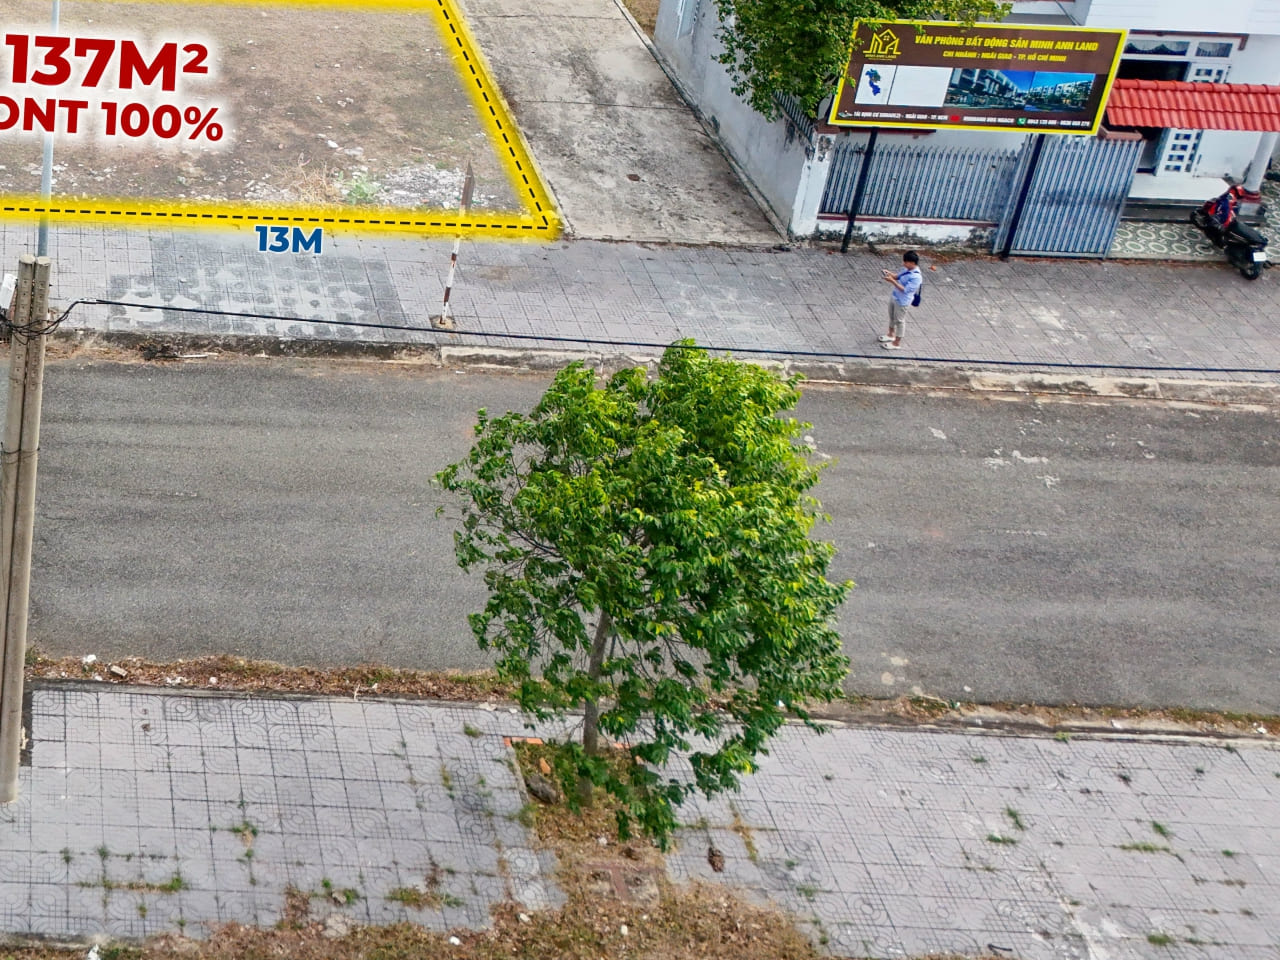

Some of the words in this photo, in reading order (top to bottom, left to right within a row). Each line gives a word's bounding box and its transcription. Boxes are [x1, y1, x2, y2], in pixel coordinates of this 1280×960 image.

[1029, 40, 1054, 50] MINH
[1054, 41, 1074, 50] ANH
[1075, 41, 1099, 51] LAND
